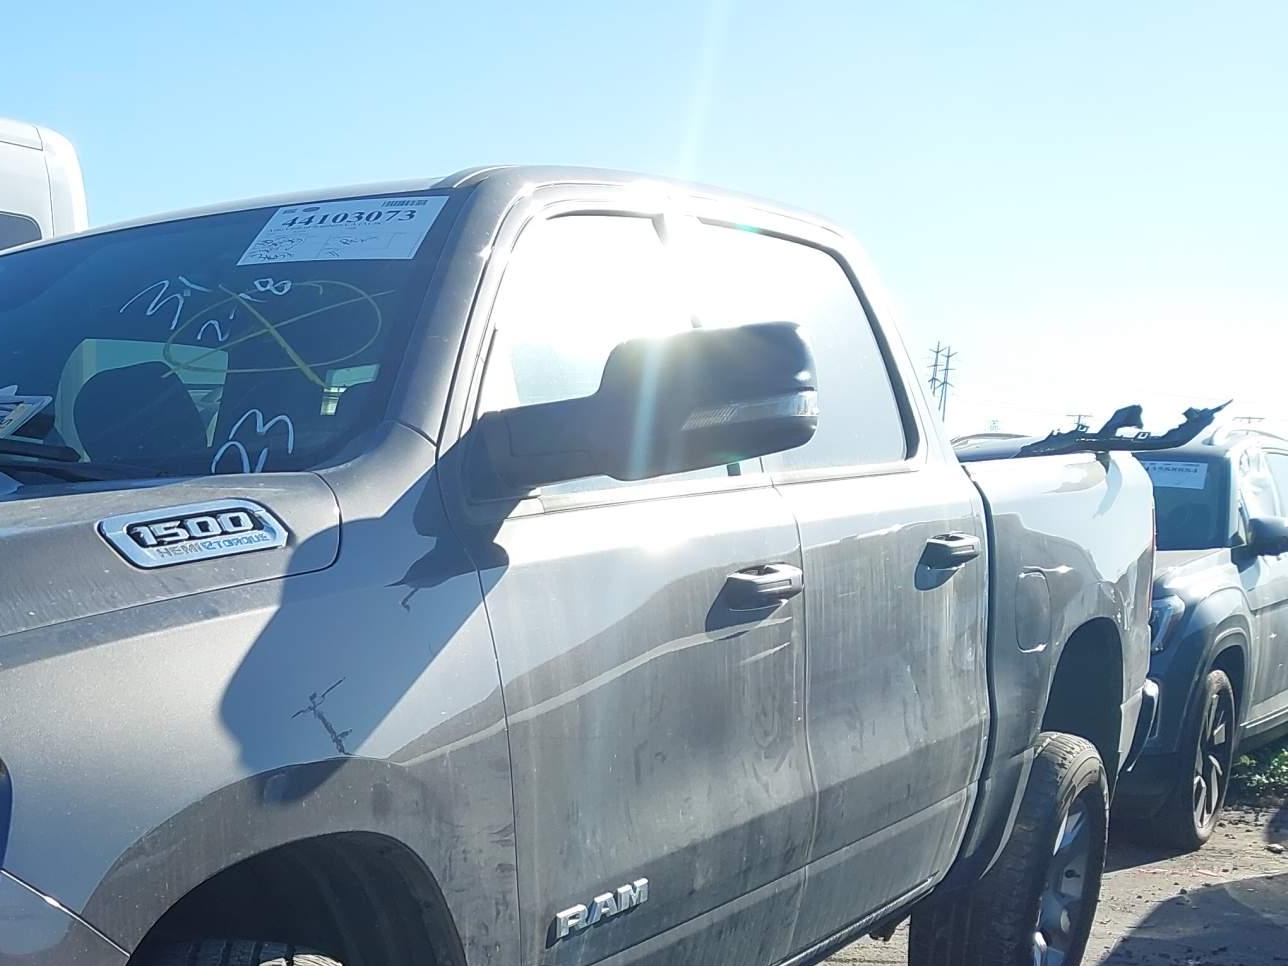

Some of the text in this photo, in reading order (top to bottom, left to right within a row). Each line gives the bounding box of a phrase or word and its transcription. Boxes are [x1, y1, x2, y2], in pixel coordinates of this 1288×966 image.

[282, 208, 417, 227] 44103073
[132, 511, 254, 546] 1500
[155, 541, 202, 558] HEMI
[547, 877, 649, 948] RAM
